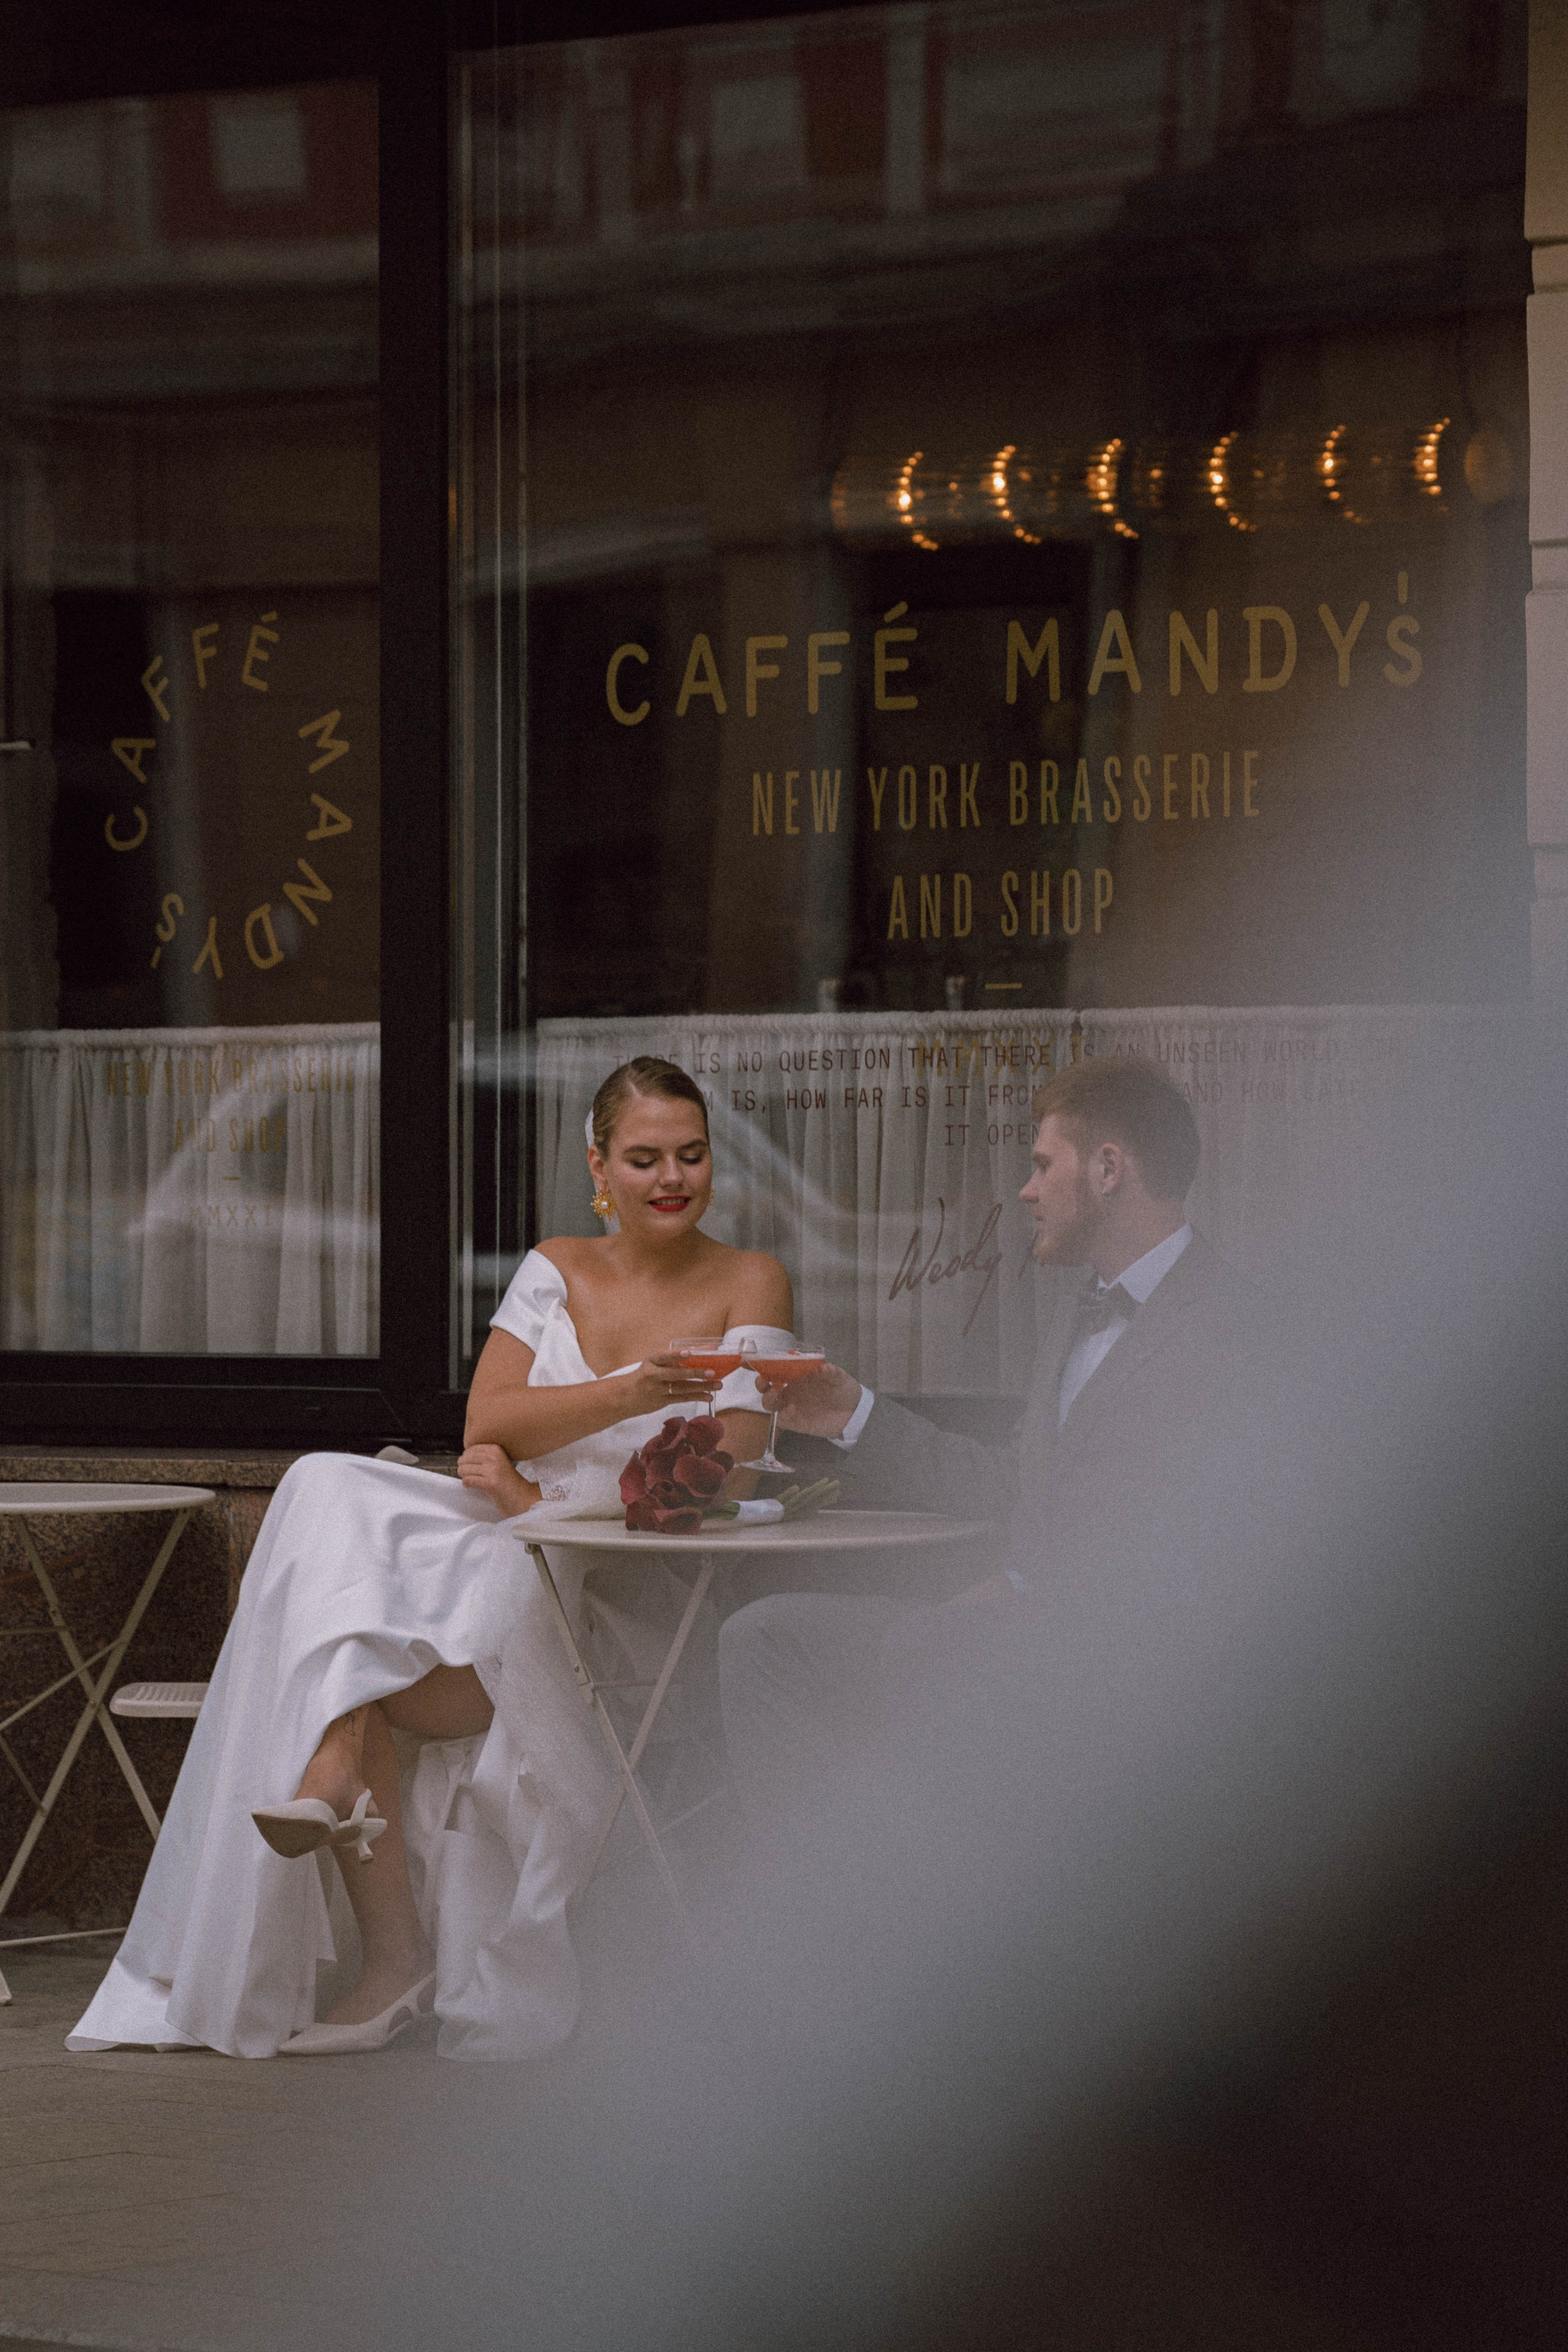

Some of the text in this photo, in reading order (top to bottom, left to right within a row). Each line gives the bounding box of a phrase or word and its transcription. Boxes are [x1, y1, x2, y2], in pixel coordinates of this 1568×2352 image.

[606, 601, 919, 726] CAFFÉ
[104, 611, 280, 851] CAFFÉ
[752, 750, 1260, 837] NEW YORK BRASSERIE
[888, 868, 1114, 940] AND SHOP
[106, 1057, 355, 1096] NEW YORK BRASSERIE
[696, 1052, 721, 1074] IS
[737, 1050, 764, 1073] NO
[778, 1047, 891, 1072] QUESTION
[908, 1046, 962, 1068] THAT
[980, 1045, 1050, 1067] THERE
[1157, 1041, 1246, 1064] UNSEEN
[732, 1090, 767, 1114] IS,
[786, 1088, 827, 1110] HOW
[844, 1087, 884, 1109] FAR
[901, 1086, 927, 1108] IS
[944, 1085, 970, 1107] IT
[173, 1115, 285, 1154] AND SHOP
[944, 1124, 970, 1146] IT
